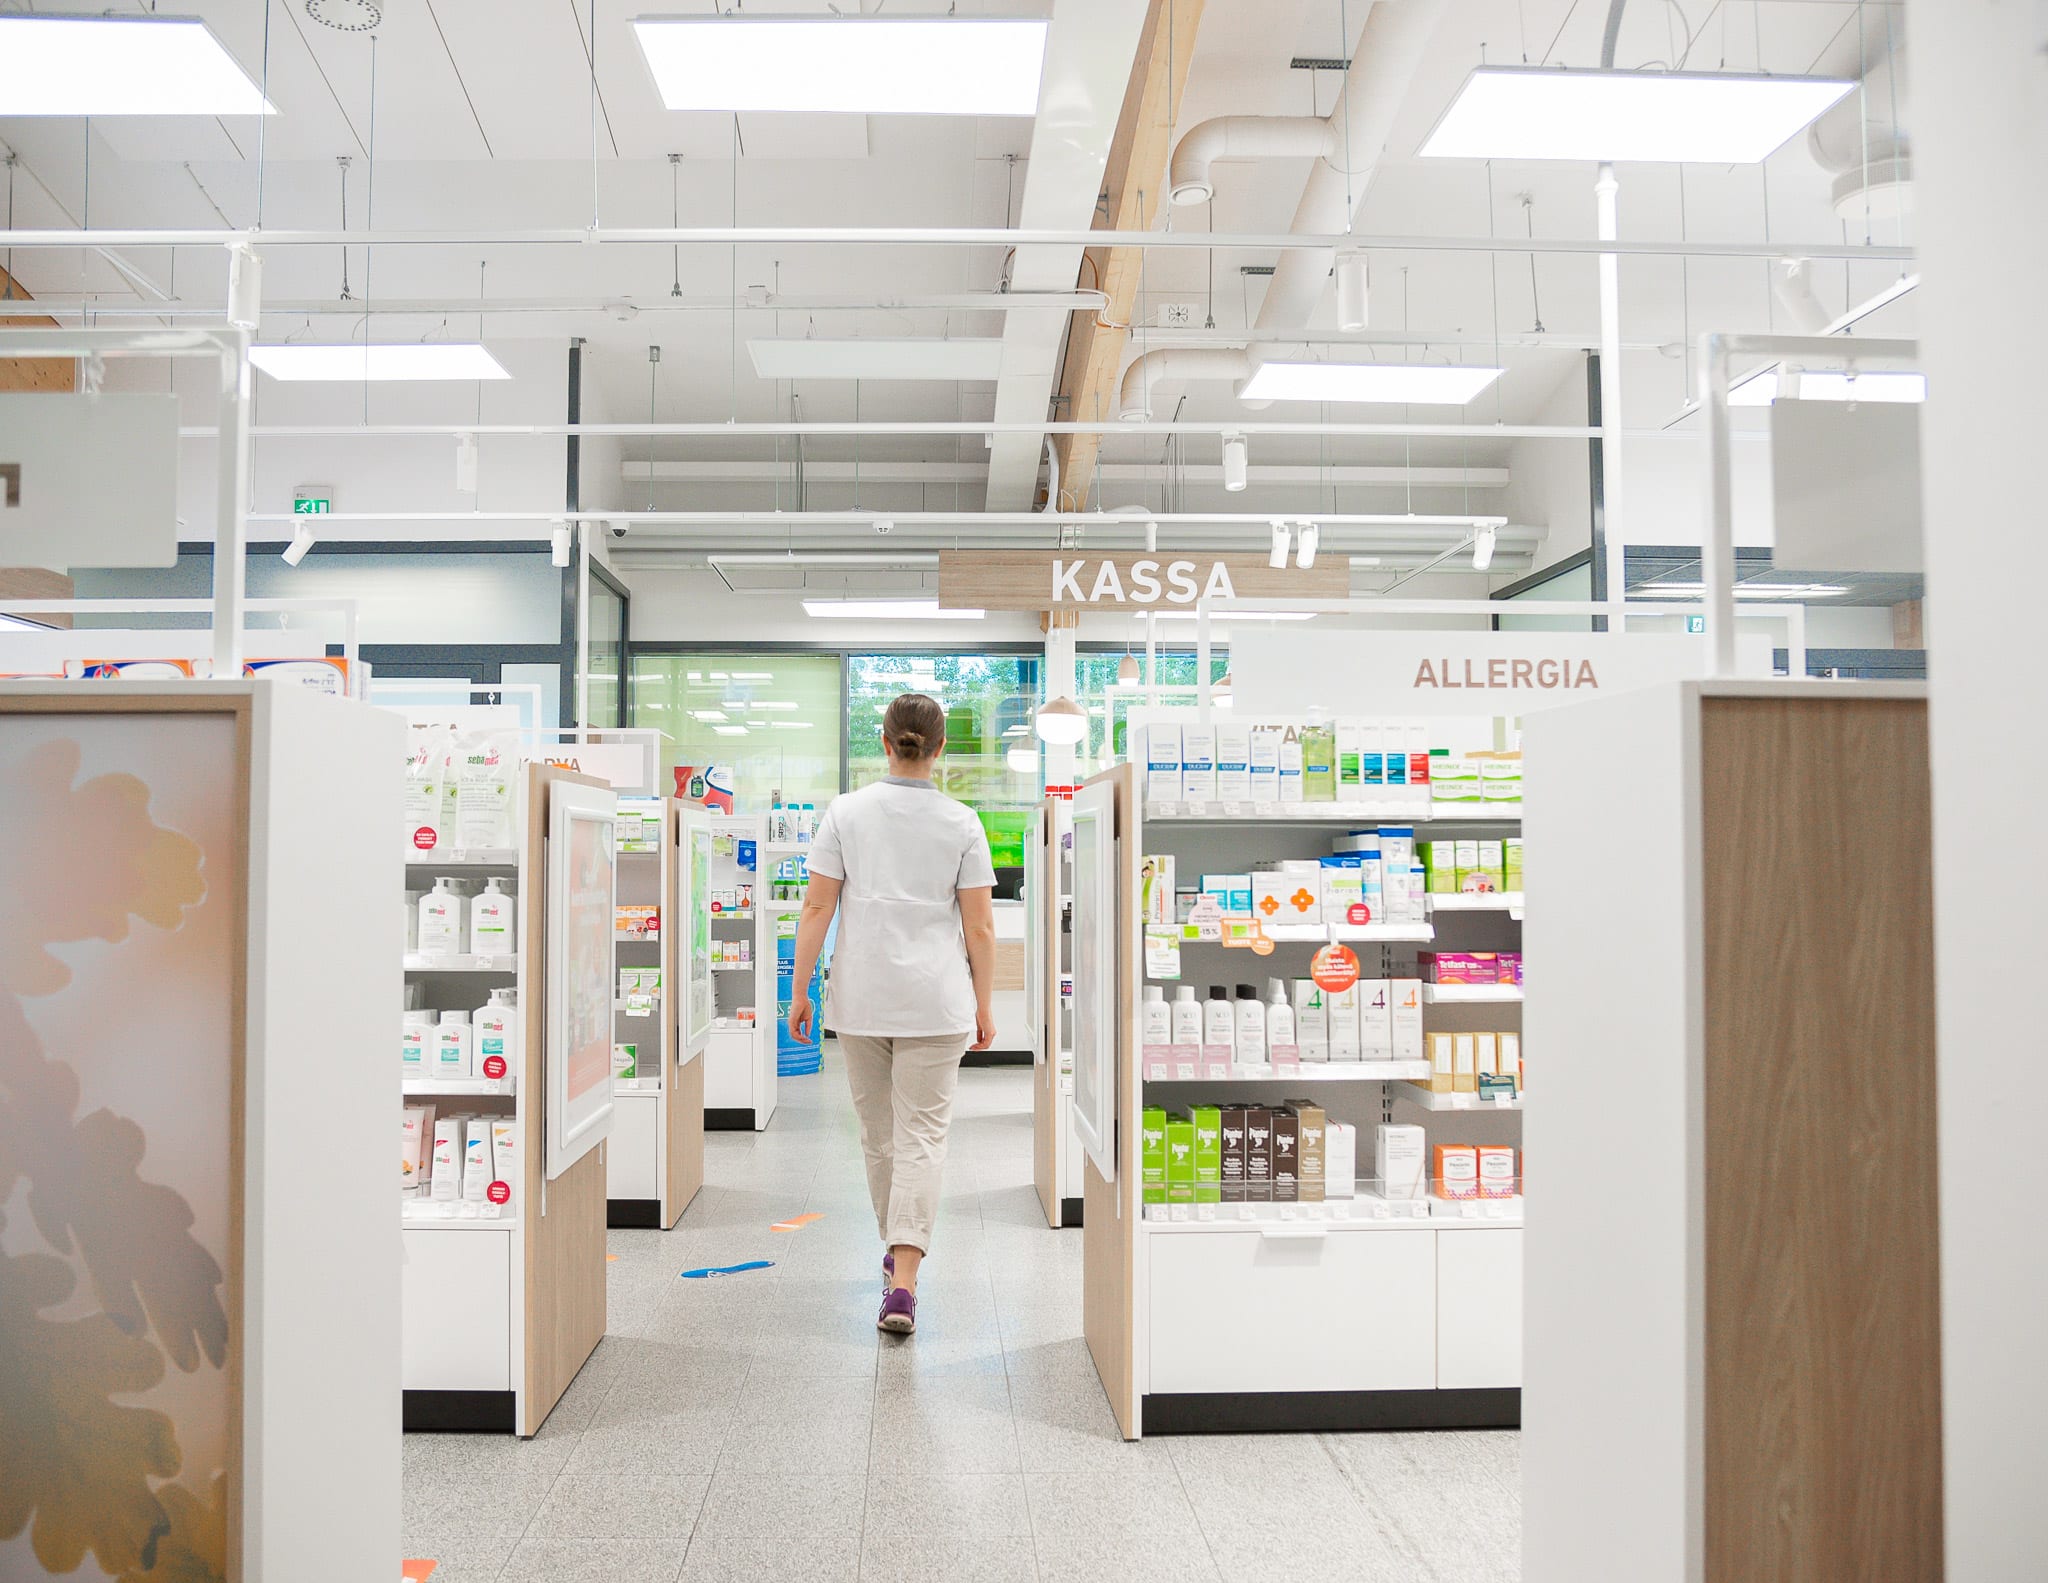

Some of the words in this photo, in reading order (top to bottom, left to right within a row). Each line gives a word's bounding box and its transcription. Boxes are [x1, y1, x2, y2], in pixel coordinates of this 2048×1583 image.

[1052, 559, 1236, 603] KASSA
[1413, 658, 1598, 688] ALLERGIA
[1307, 989, 1322, 1009] 4
[1340, 988, 1354, 1009] 4
[1372, 988, 1386, 1009] 4
[1403, 988, 1417, 1009] 4
